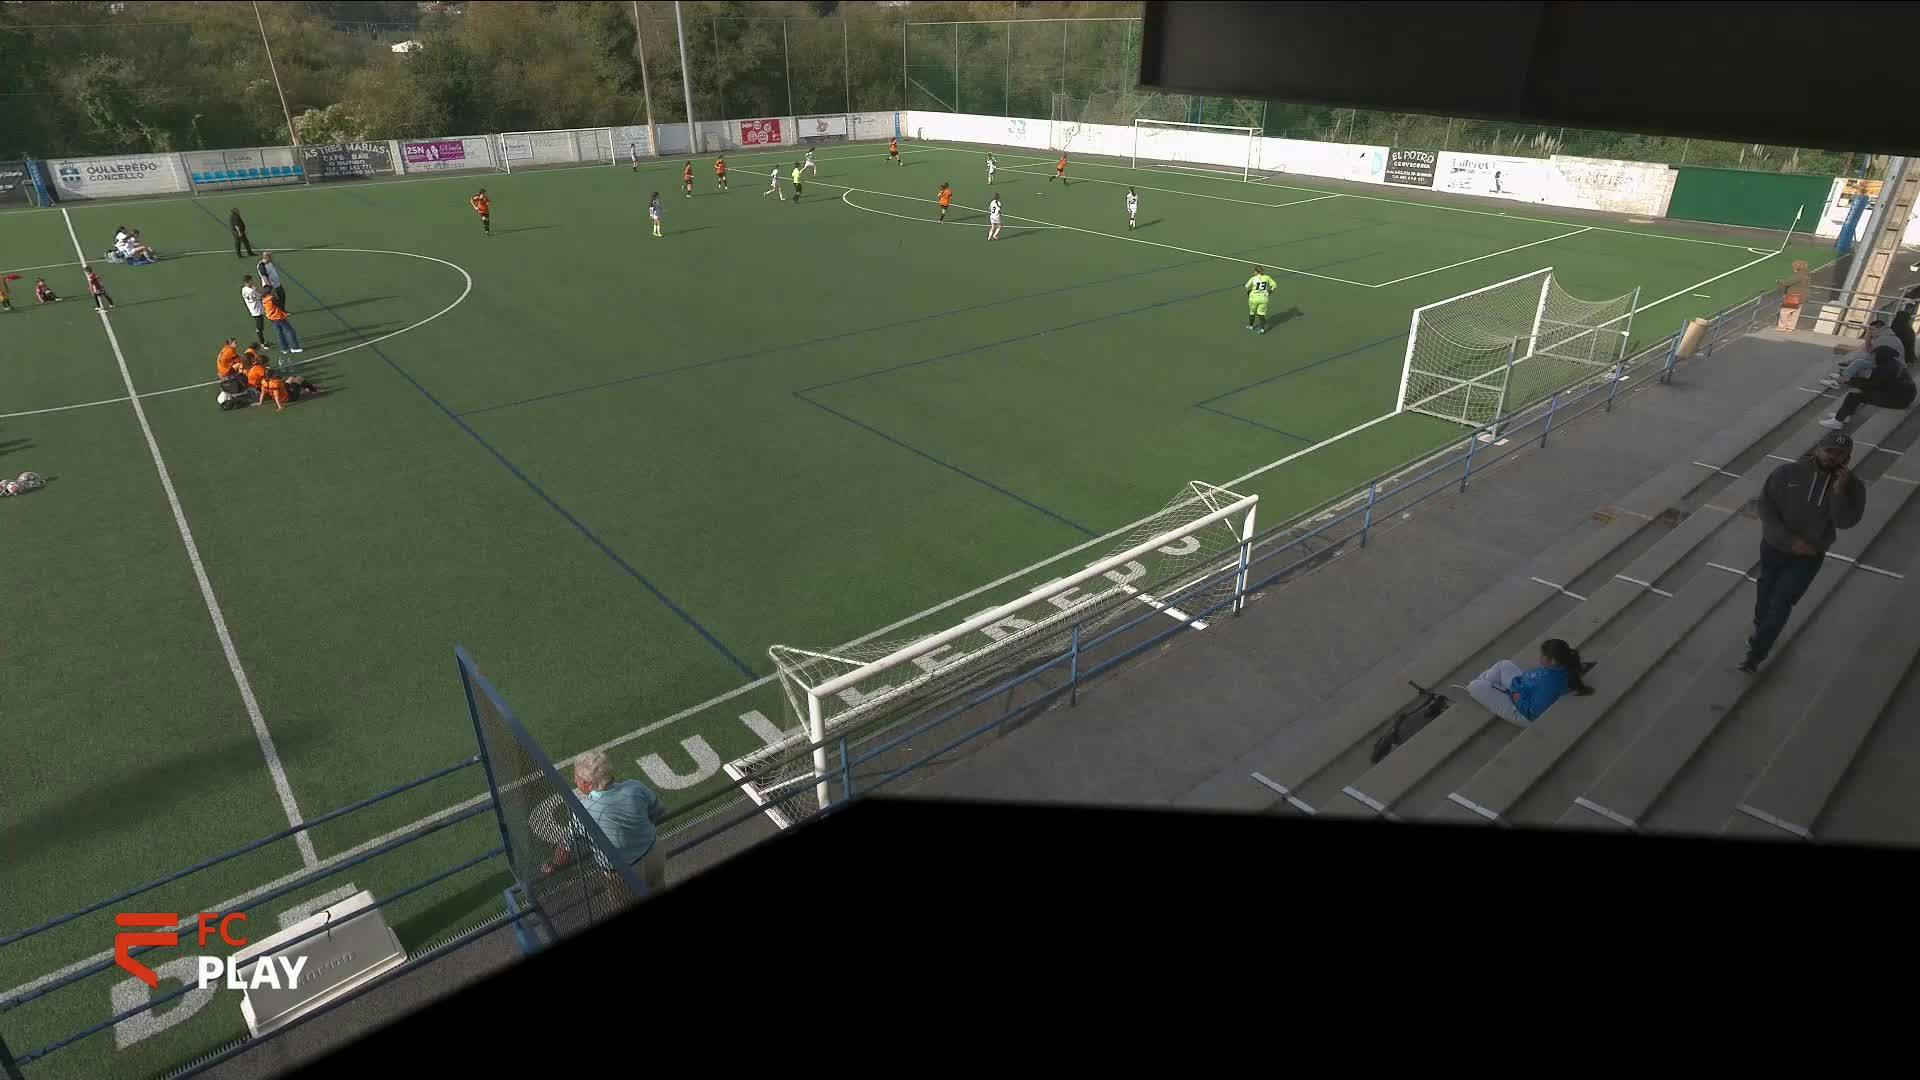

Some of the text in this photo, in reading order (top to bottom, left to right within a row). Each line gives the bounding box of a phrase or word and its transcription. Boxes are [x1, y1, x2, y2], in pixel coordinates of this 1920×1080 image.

[304, 143, 386, 160] AS TRES MARIAS
[406, 146, 425, 155] 25N
[1392, 151, 1435, 164] EL POTRO
[89, 172, 144, 181] CONCELLO
[1255, 281, 1268, 291] 13
